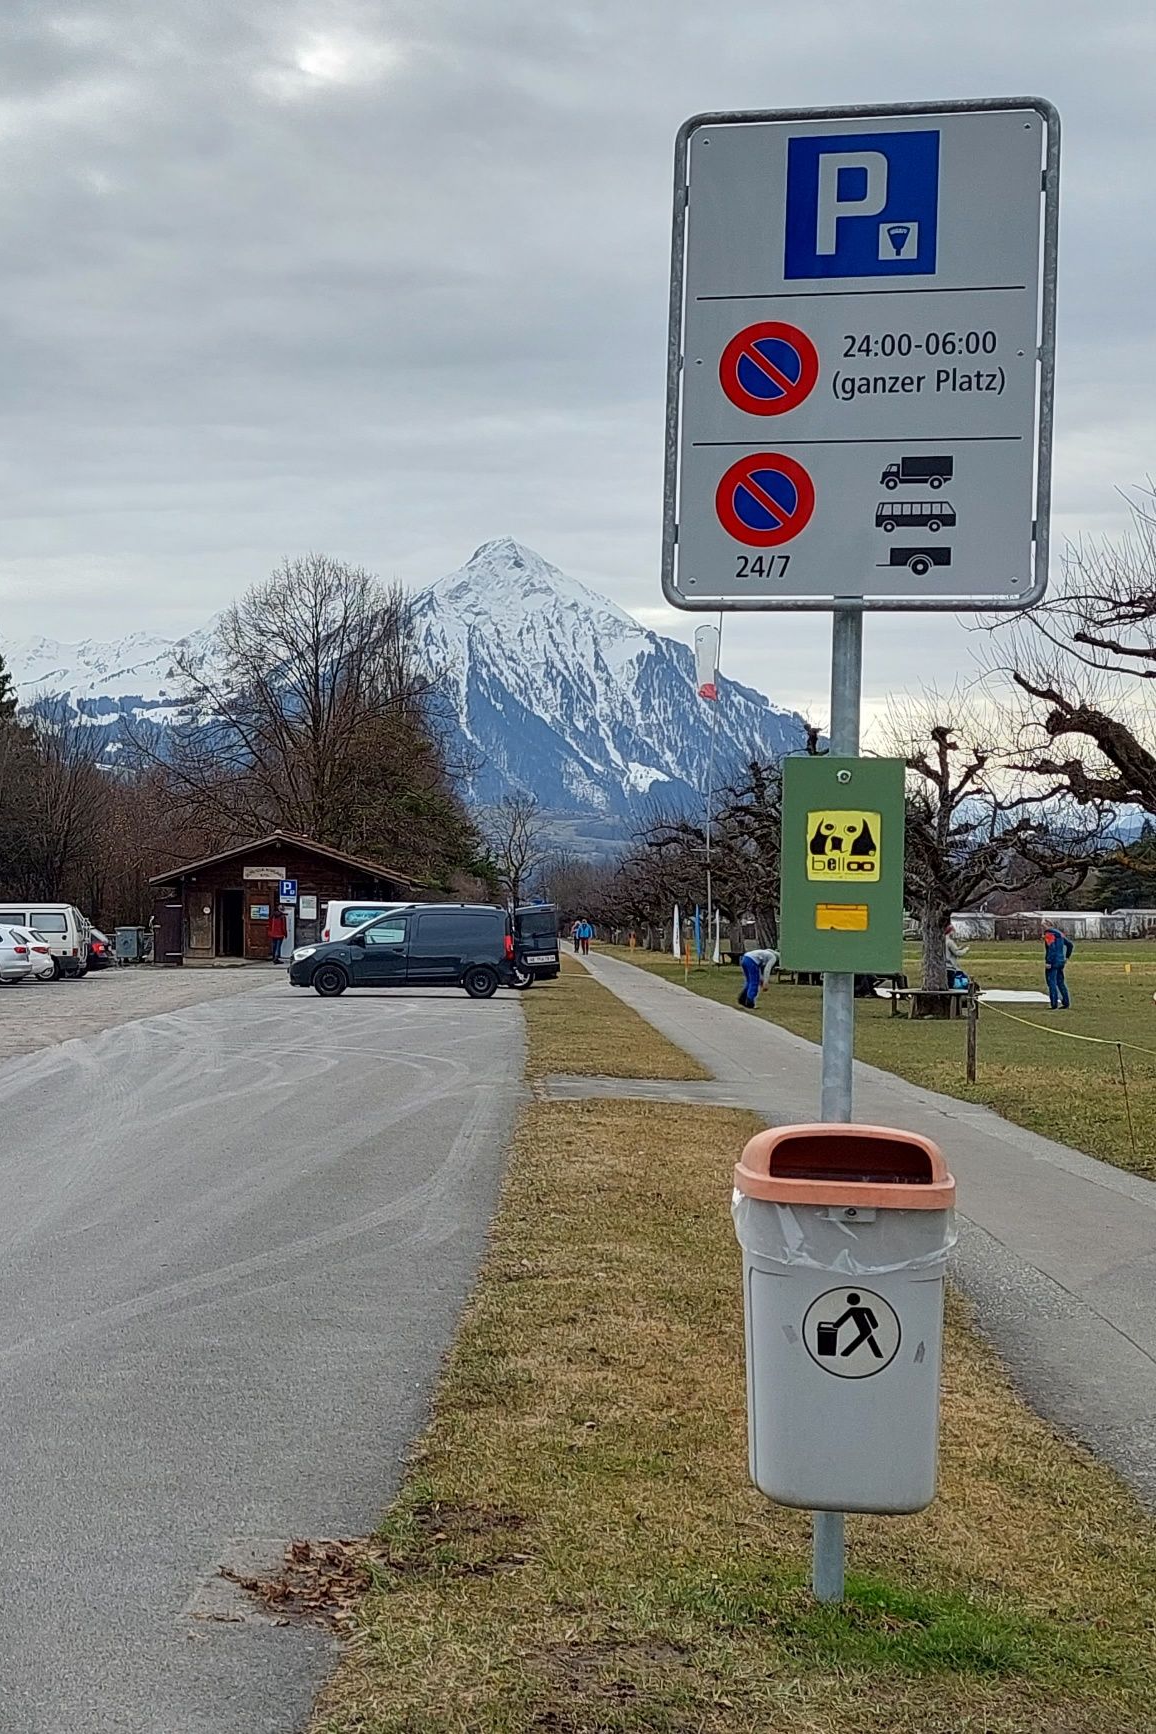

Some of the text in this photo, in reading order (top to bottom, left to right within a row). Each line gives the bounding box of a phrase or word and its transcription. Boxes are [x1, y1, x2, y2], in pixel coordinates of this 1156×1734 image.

[816, 151, 888, 255] P
[842, 330, 997, 358] 24:00-06:00
[832, 366, 1006, 401] (ganzer Platz)
[735, 555, 791, 579] 24/7
[812, 856, 875, 871] belloo
